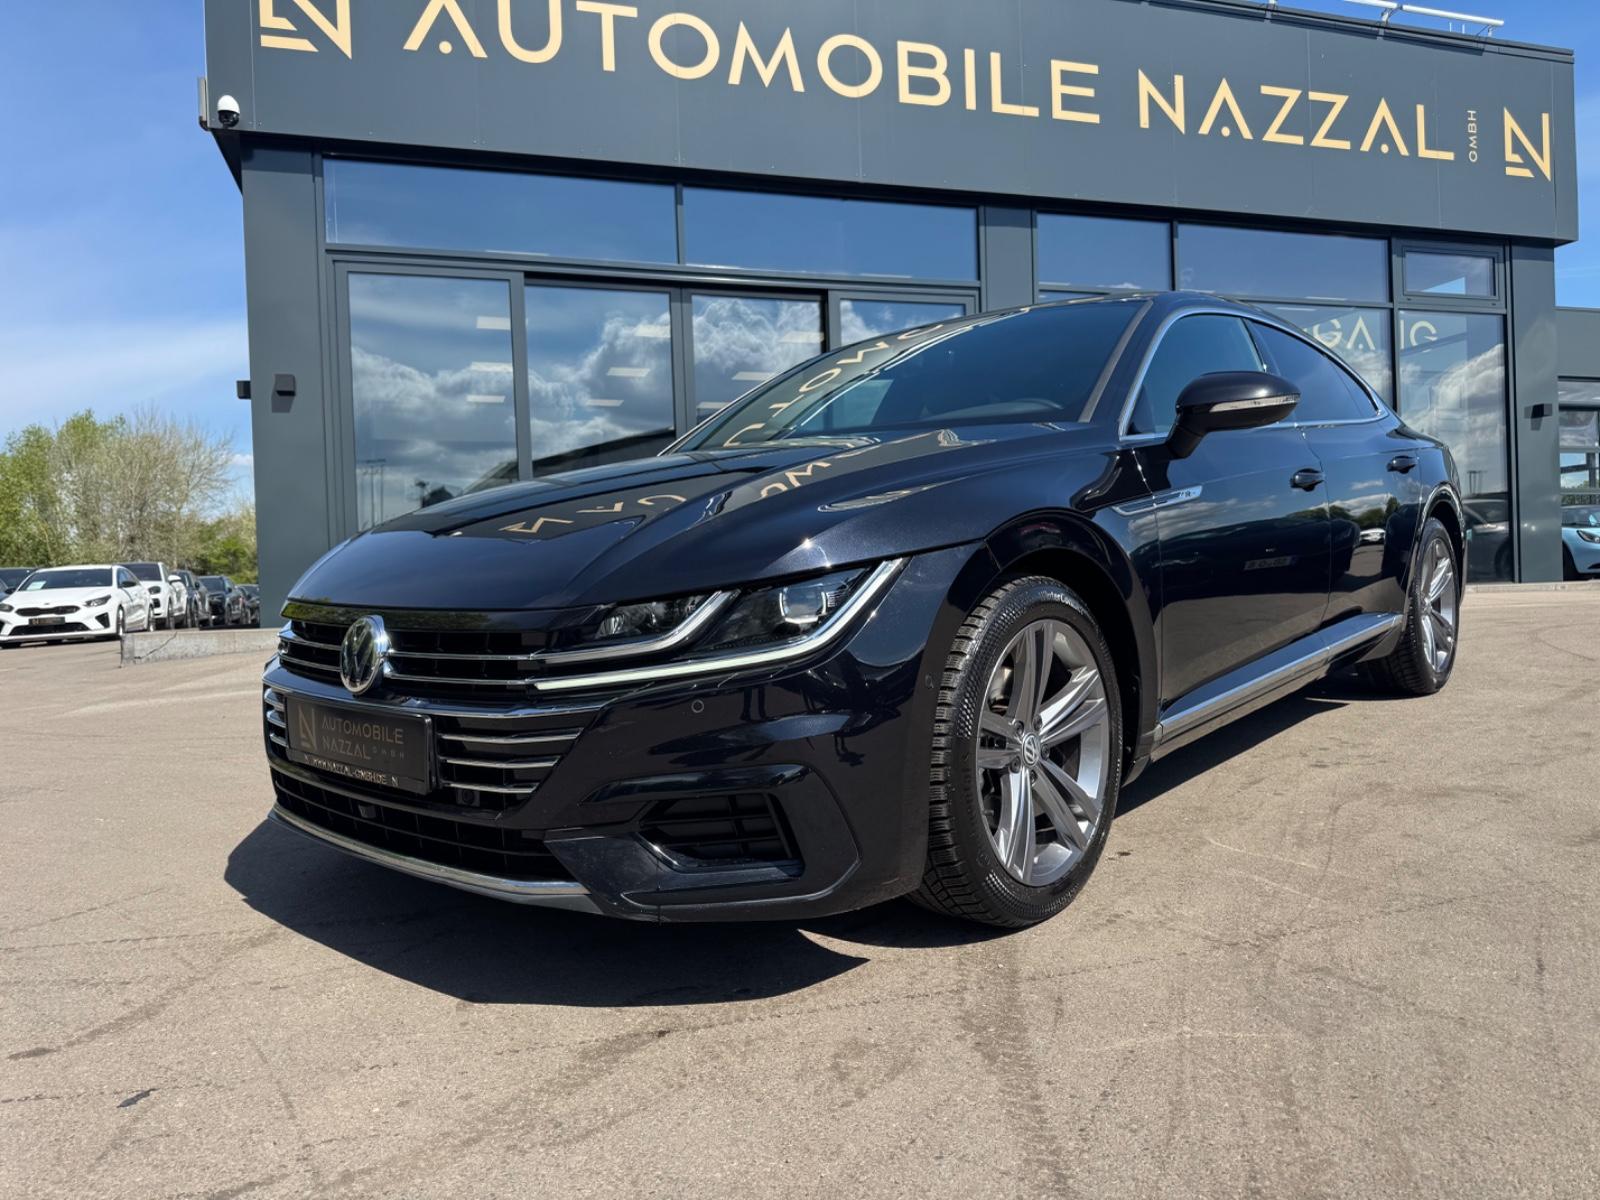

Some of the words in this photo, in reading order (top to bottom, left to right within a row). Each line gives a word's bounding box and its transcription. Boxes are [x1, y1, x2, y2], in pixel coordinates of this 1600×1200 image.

[402, 0, 1101, 124] AUTOMOBILE
[1138, 73, 1455, 162] NAZZAL
[322, 716, 404, 744] AUTOMOBILE
[322, 737, 371, 760] NAZZAL
